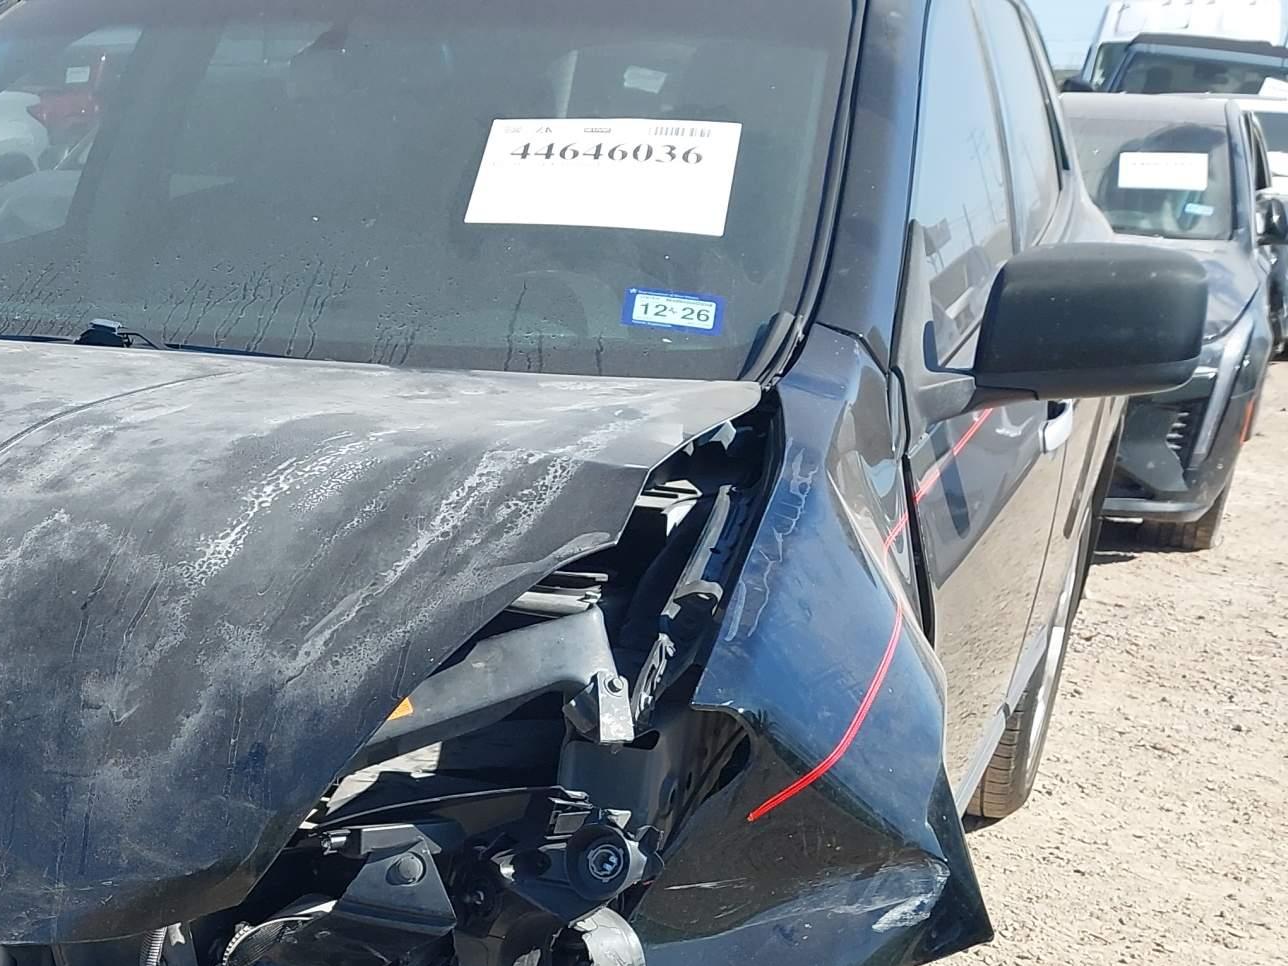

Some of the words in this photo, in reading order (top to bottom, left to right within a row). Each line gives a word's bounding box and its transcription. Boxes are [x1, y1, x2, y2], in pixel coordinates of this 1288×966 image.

[510, 142, 703, 164] 44646036
[640, 302, 669, 318] 12
[681, 306, 711, 322] 26
